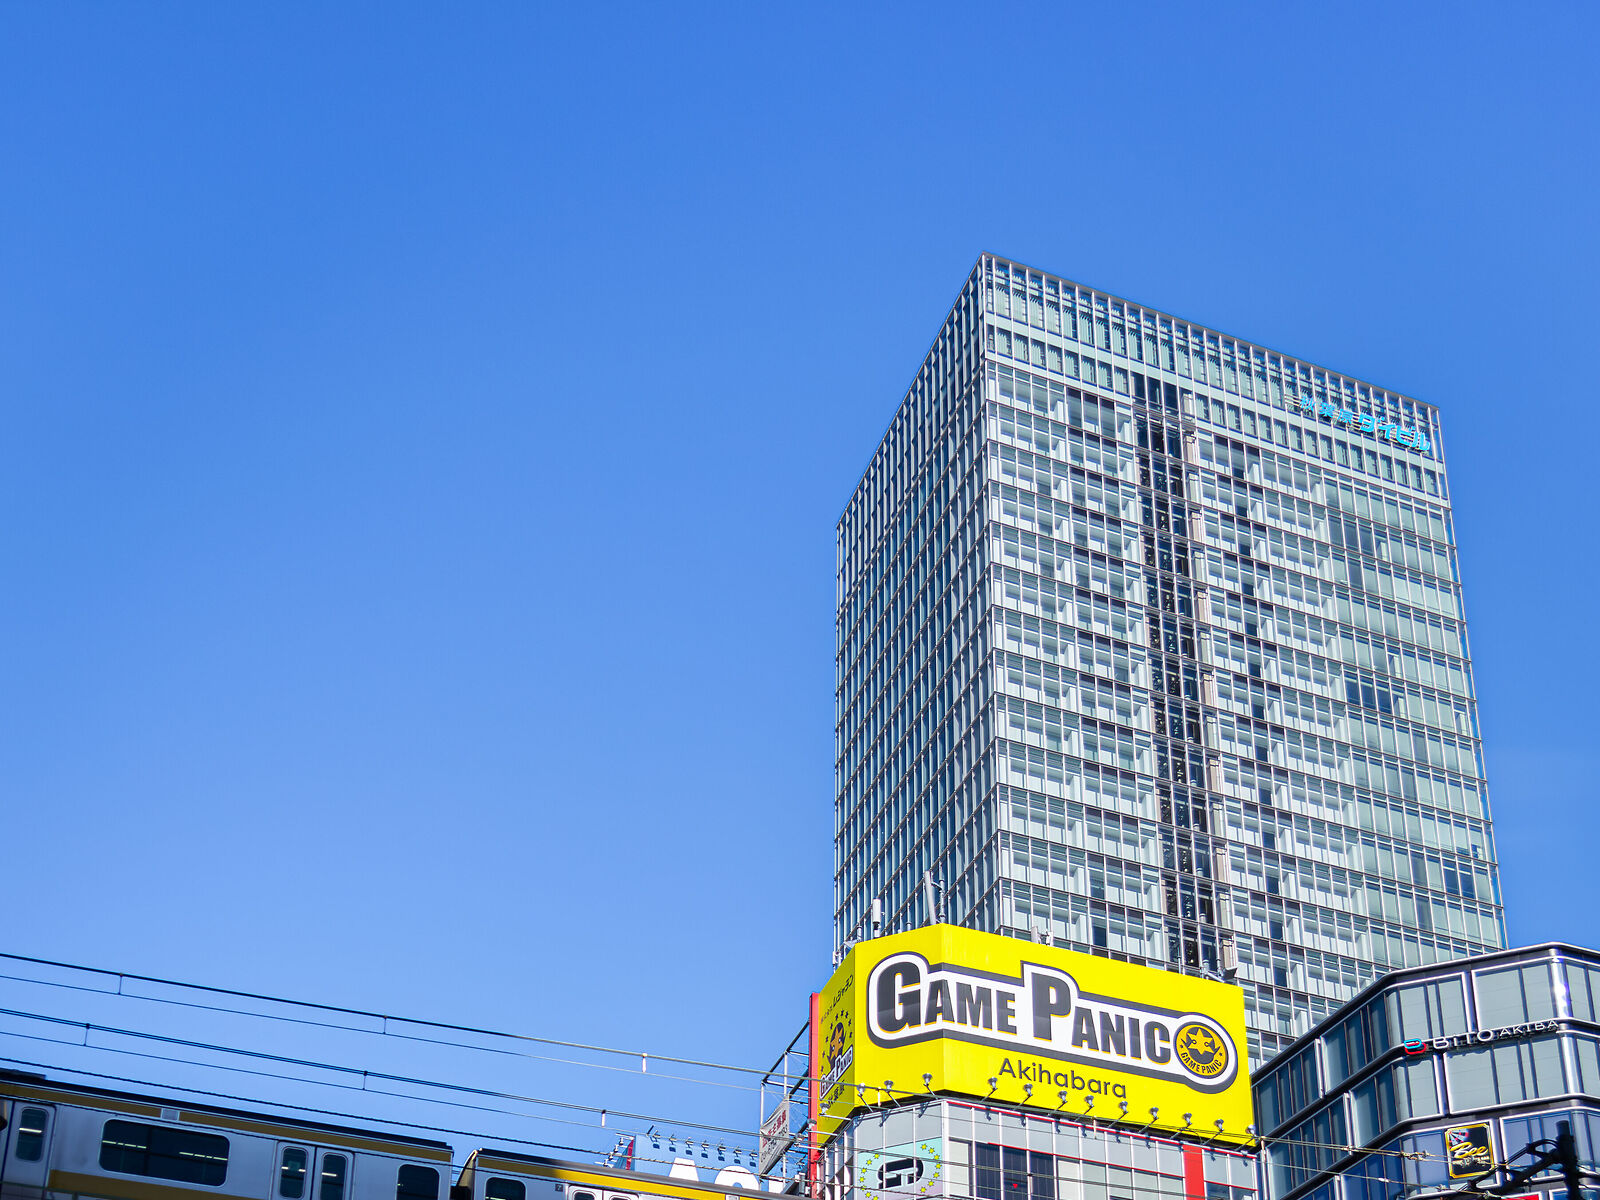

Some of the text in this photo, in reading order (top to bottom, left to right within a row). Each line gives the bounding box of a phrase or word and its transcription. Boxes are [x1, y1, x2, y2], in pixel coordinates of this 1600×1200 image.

[876, 961, 1018, 1036] GAME
[1031, 971, 1171, 1066] PANIC
[1499, 1019, 1559, 1037] AKIBA
[1181, 1052, 1222, 1074] GAME PANIC
[998, 1057, 1127, 1100] Akihabara
[1449, 1141, 1489, 1158] Bee
